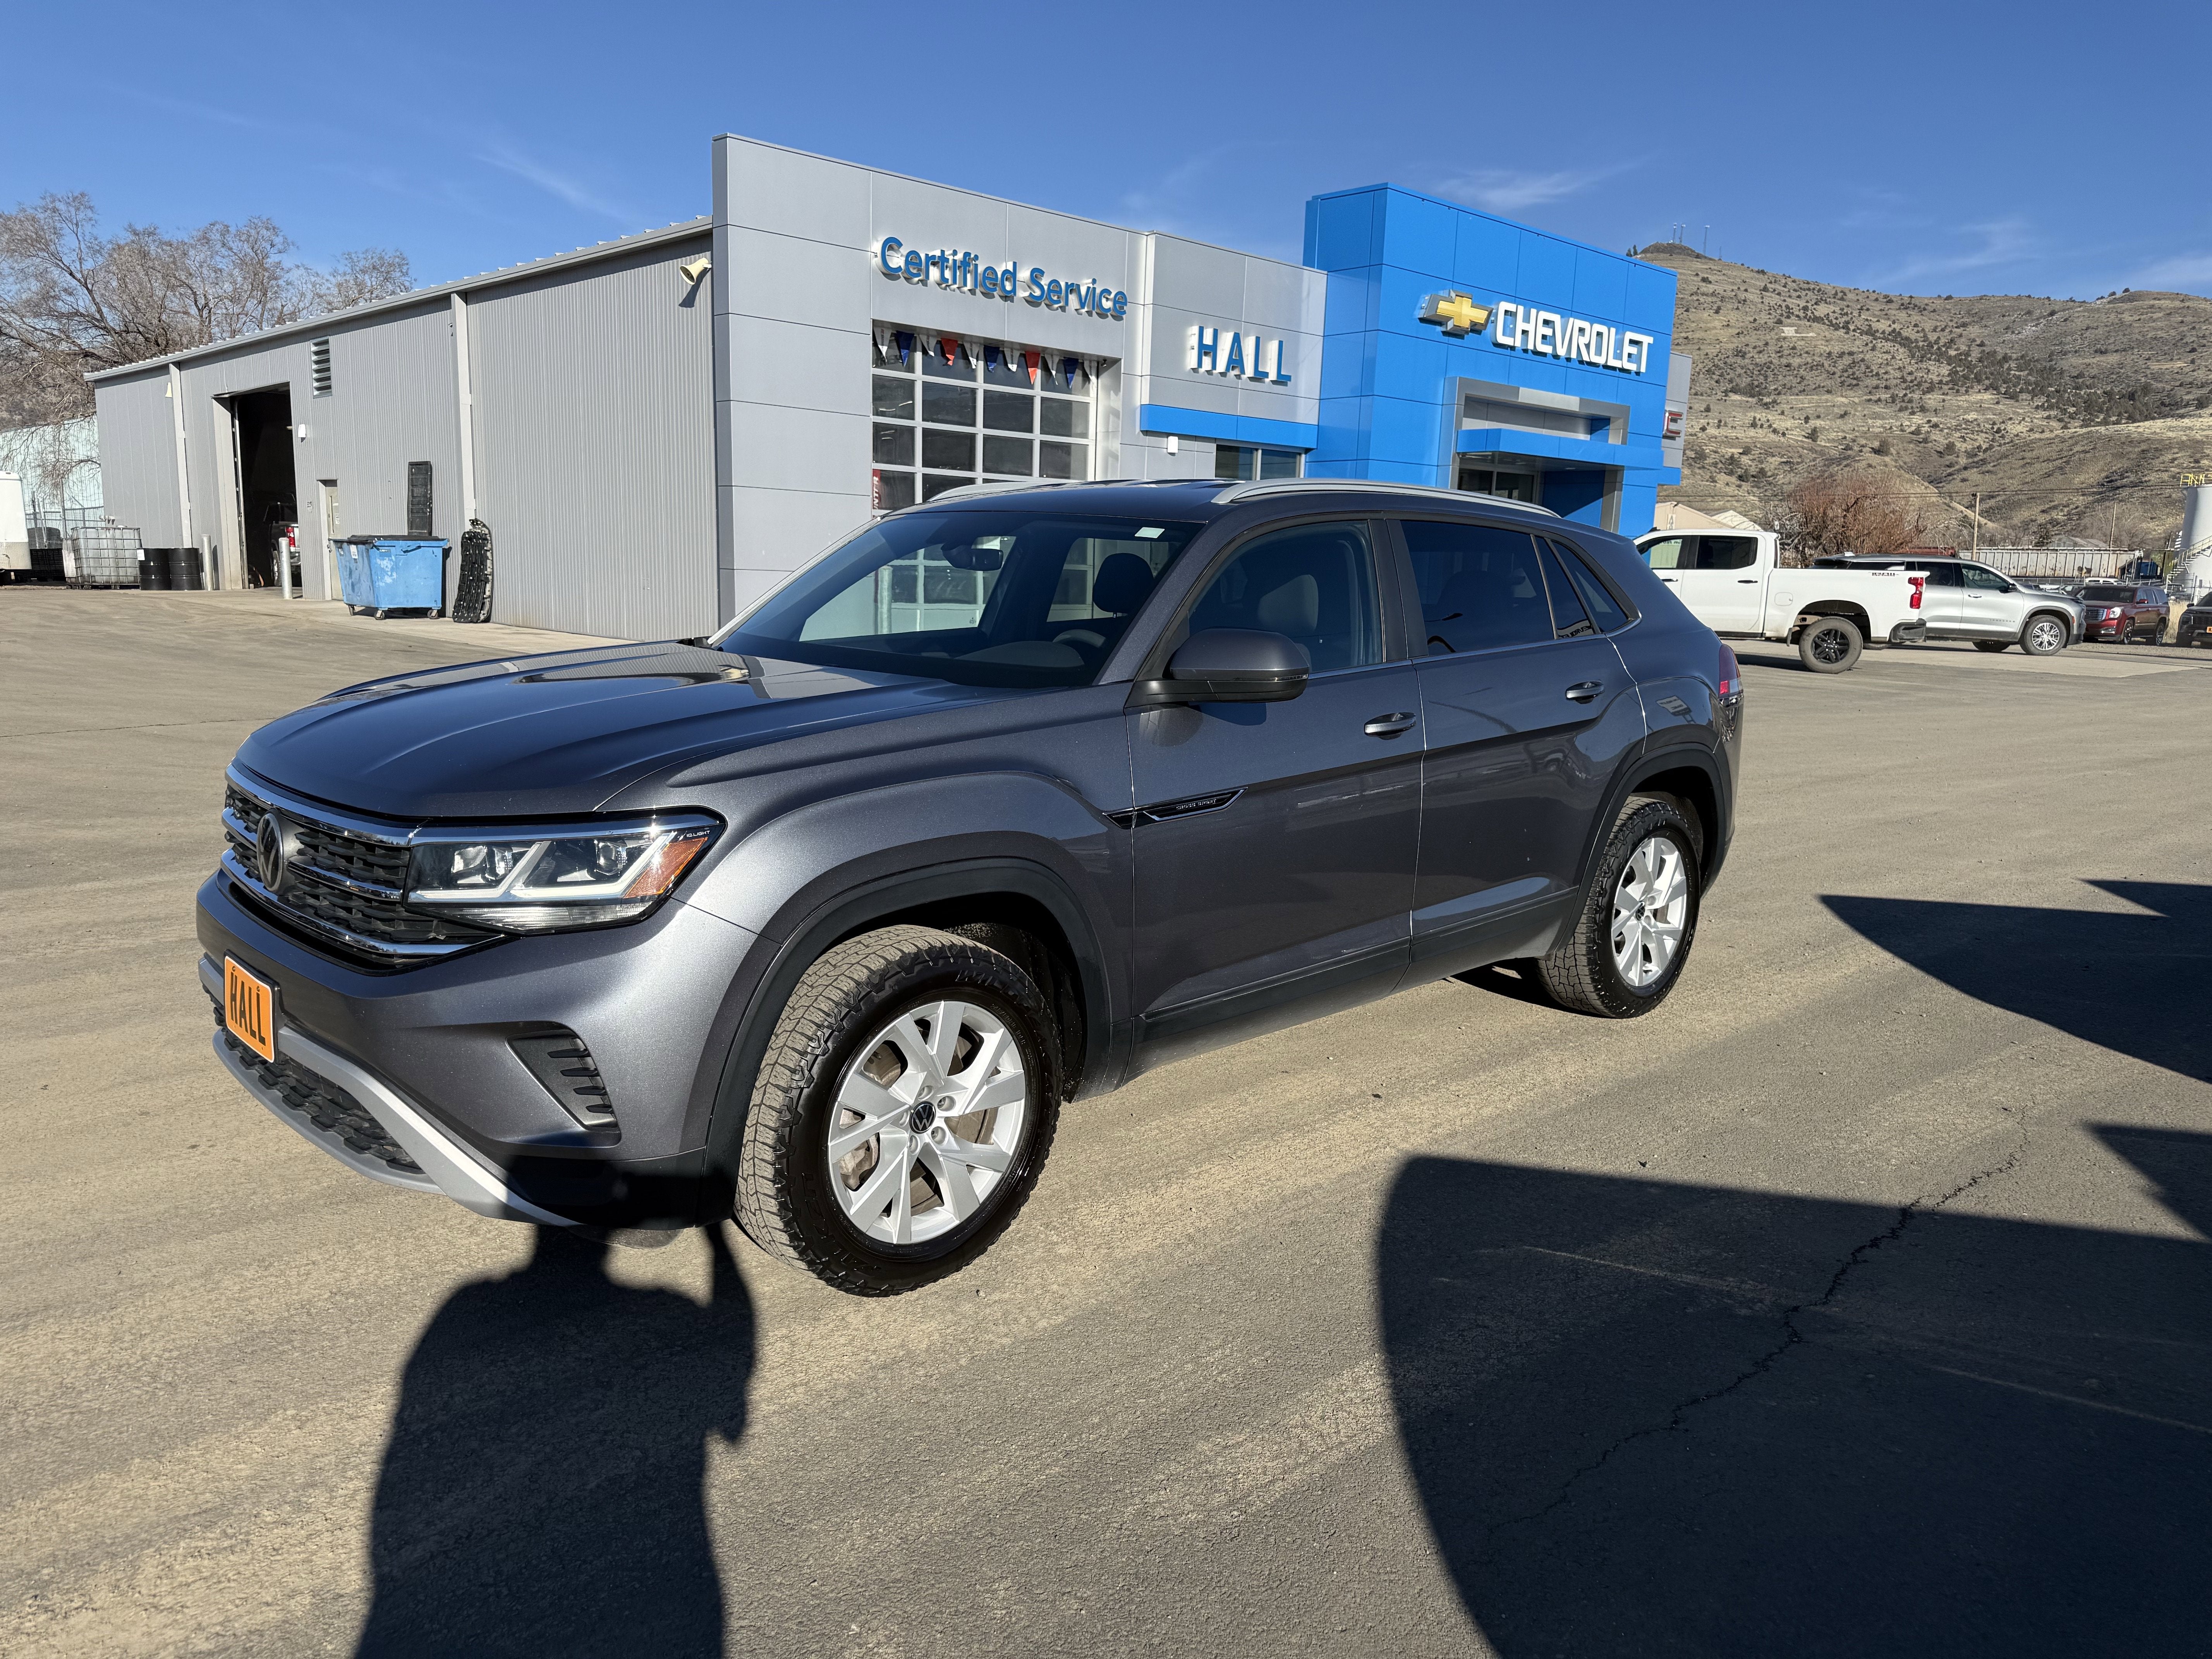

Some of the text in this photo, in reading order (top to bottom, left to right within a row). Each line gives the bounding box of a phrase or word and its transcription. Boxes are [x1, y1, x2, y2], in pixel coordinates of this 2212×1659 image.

[880, 236, 1128, 316] Certified Service
[1197, 325, 1292, 382] HALL
[1496, 301, 1654, 373] CHEVROLET
[230, 971, 266, 1047] HALL
[913, 1104, 934, 1131] VW
